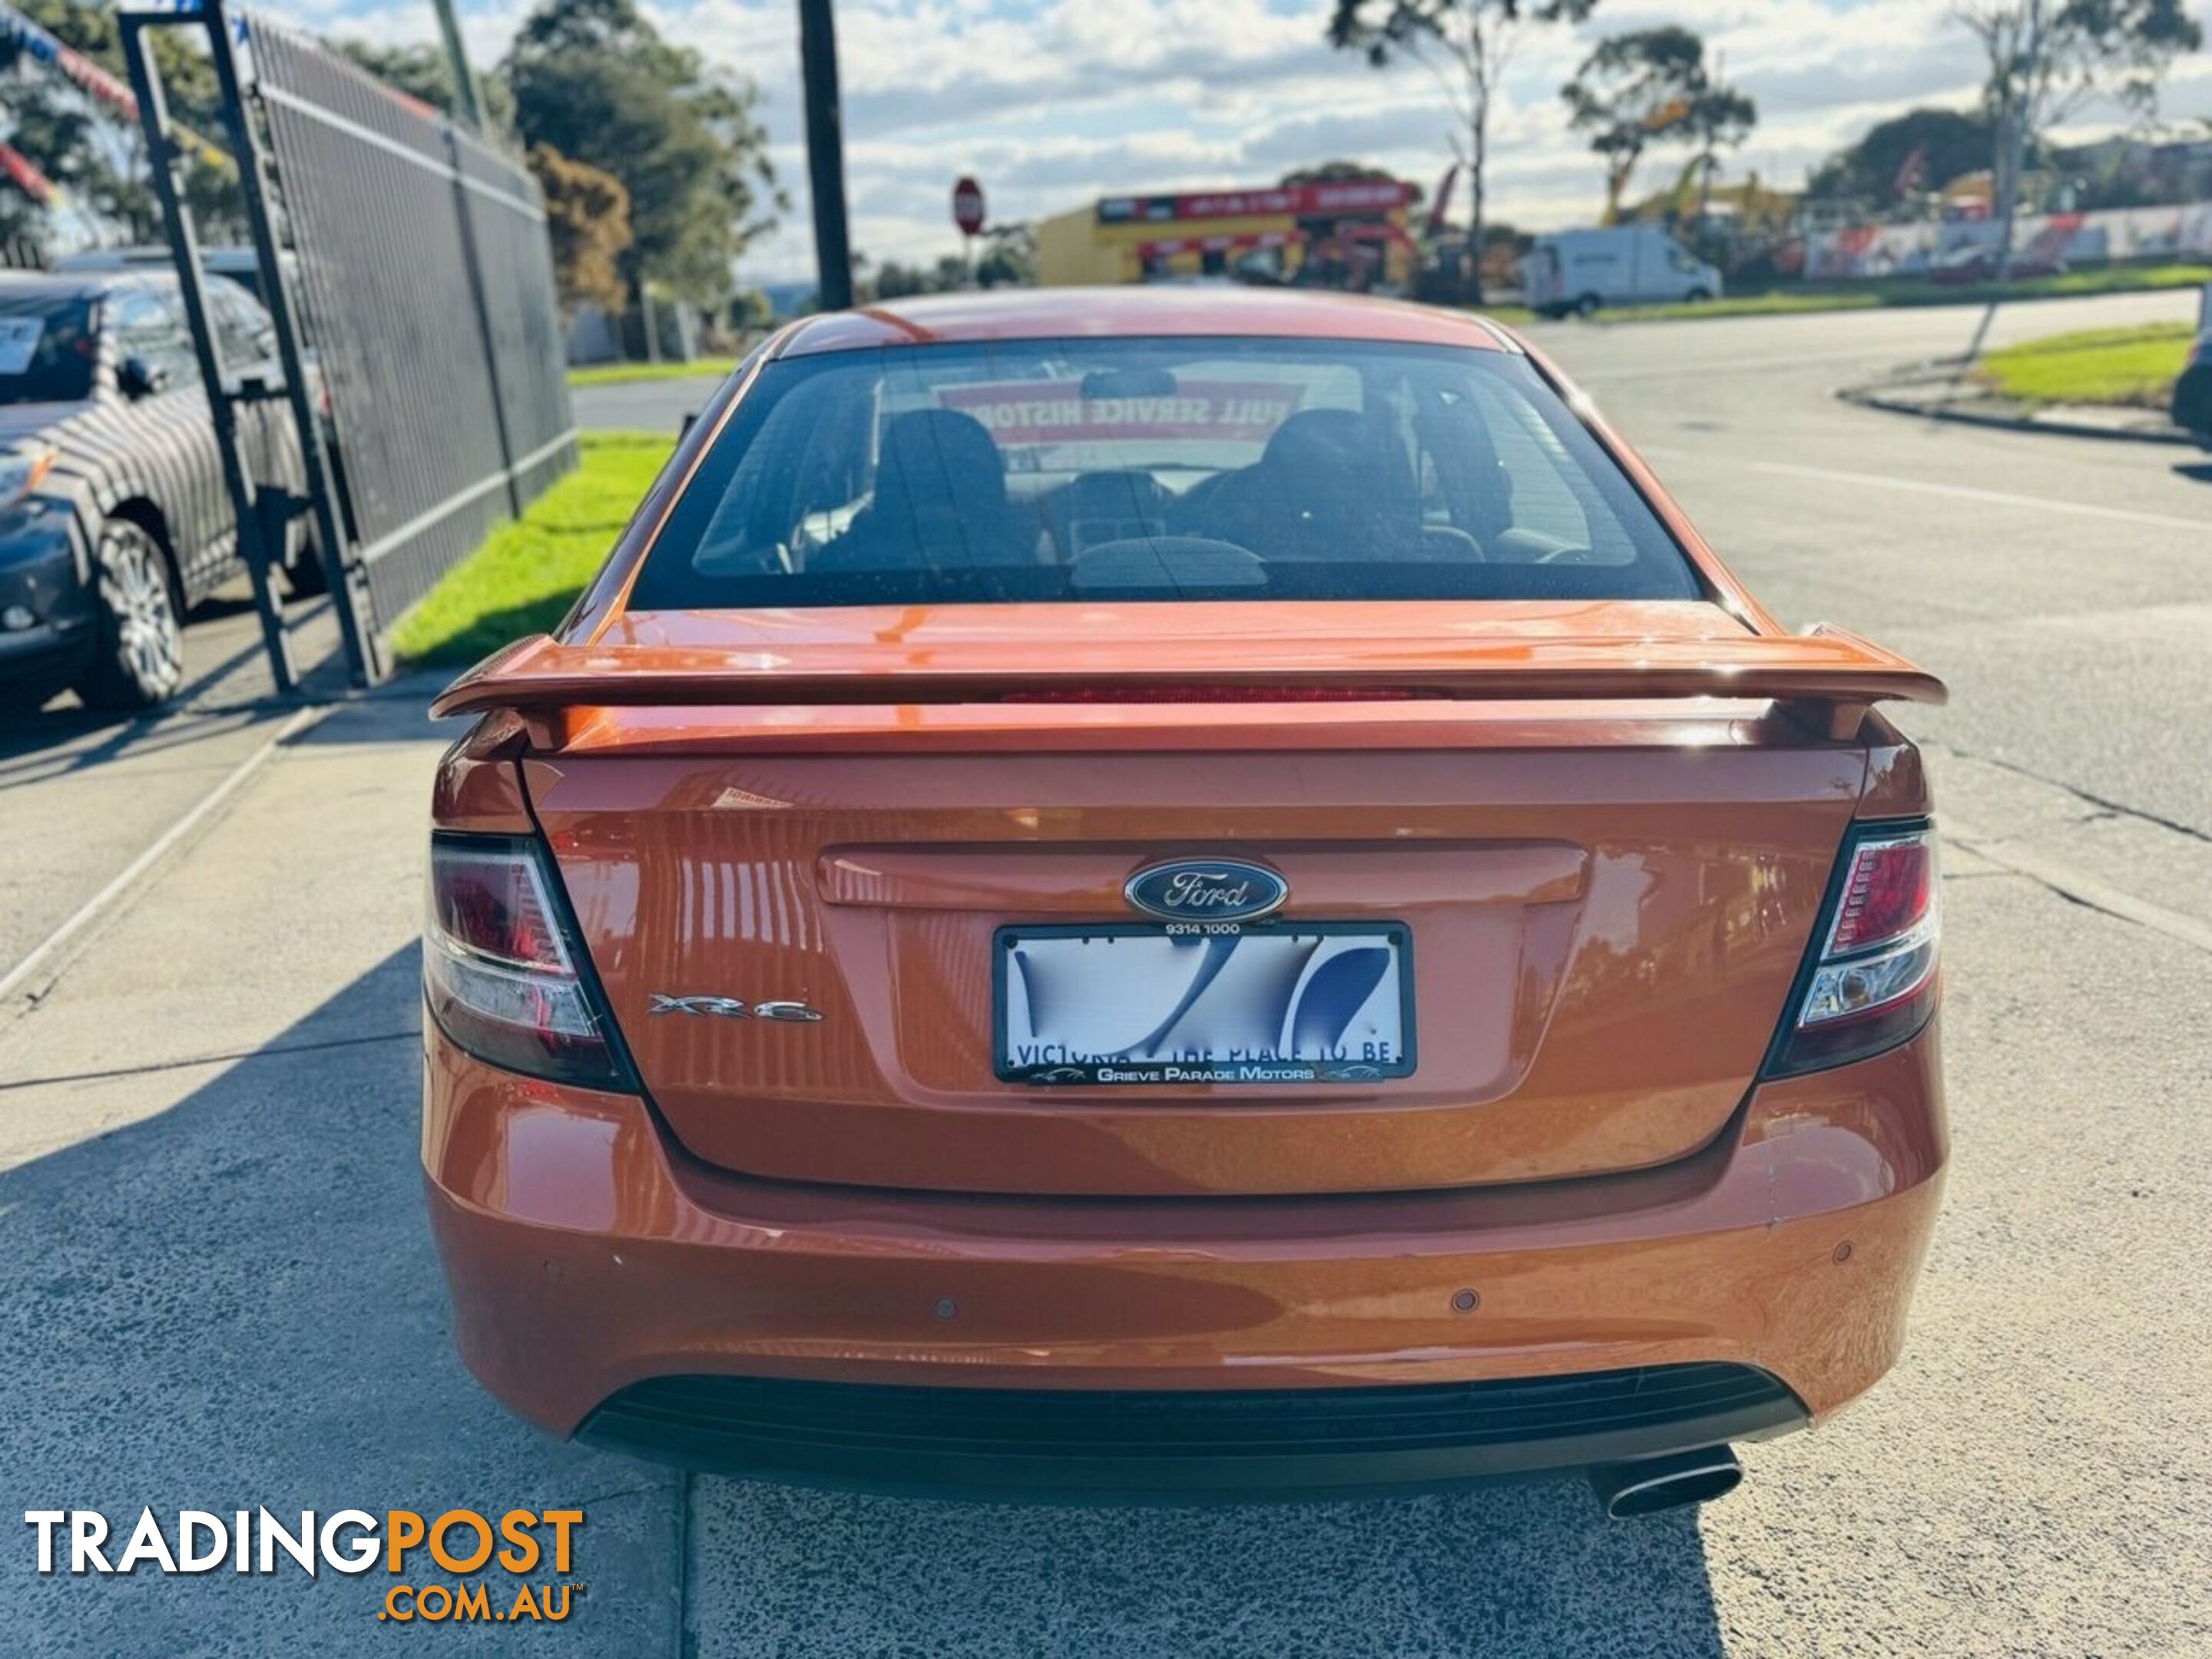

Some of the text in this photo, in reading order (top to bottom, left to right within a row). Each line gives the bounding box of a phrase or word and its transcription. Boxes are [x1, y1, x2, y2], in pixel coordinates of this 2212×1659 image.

[1163, 872, 1249, 906] Ford
[1165, 923, 1240, 935] 9314 1000
[647, 993, 824, 1022] XR6
[1363, 1041, 1389, 1062] BE
[1097, 1066, 1314, 1081] GRIEVE PARADE MOTORS
